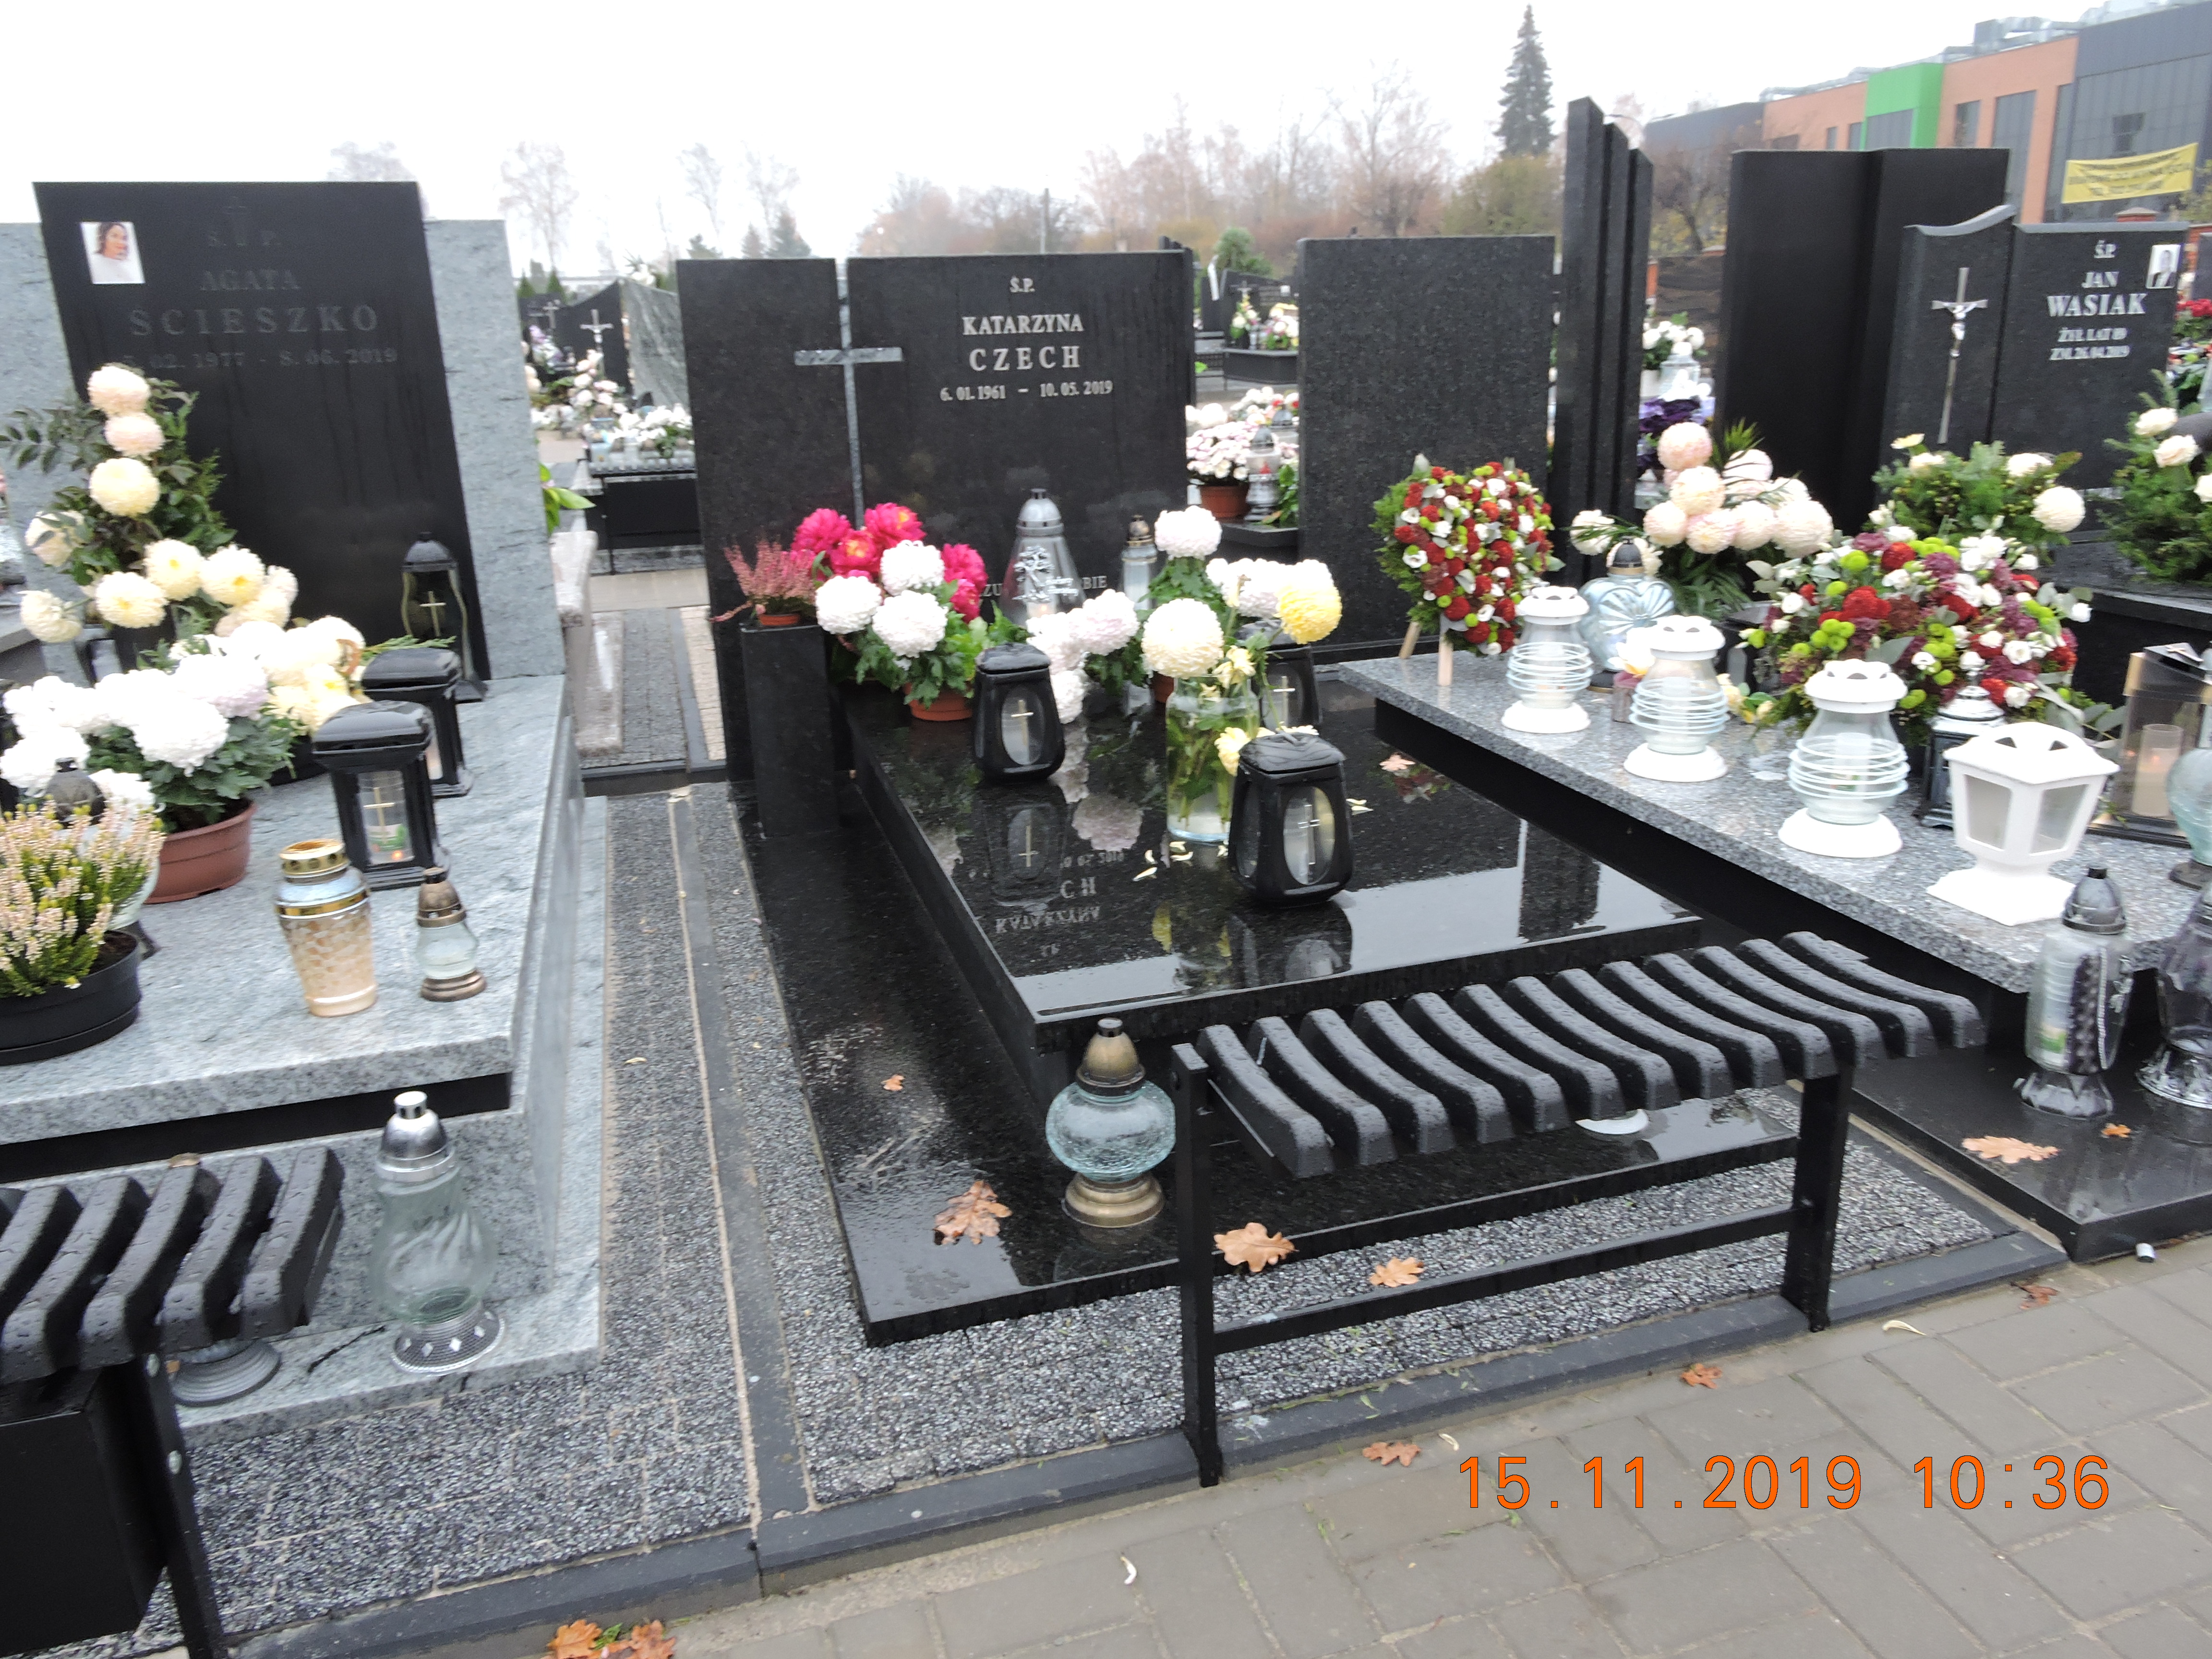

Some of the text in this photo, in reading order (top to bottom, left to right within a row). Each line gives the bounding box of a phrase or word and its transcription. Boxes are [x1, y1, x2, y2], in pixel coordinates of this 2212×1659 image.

[200, 269, 301, 291] AGATA
[2081, 271, 2119, 289] JAN
[2046, 293, 2148, 317] WASIAK
[129, 303, 378, 337] ŚCIESZKO
[962, 313, 1084, 336] KATARZYNA
[192, 351, 245, 368] 1977
[344, 348, 398, 363] 2019
[969, 346, 1081, 372] CZECH
[1082, 380, 1114, 395] 2019
